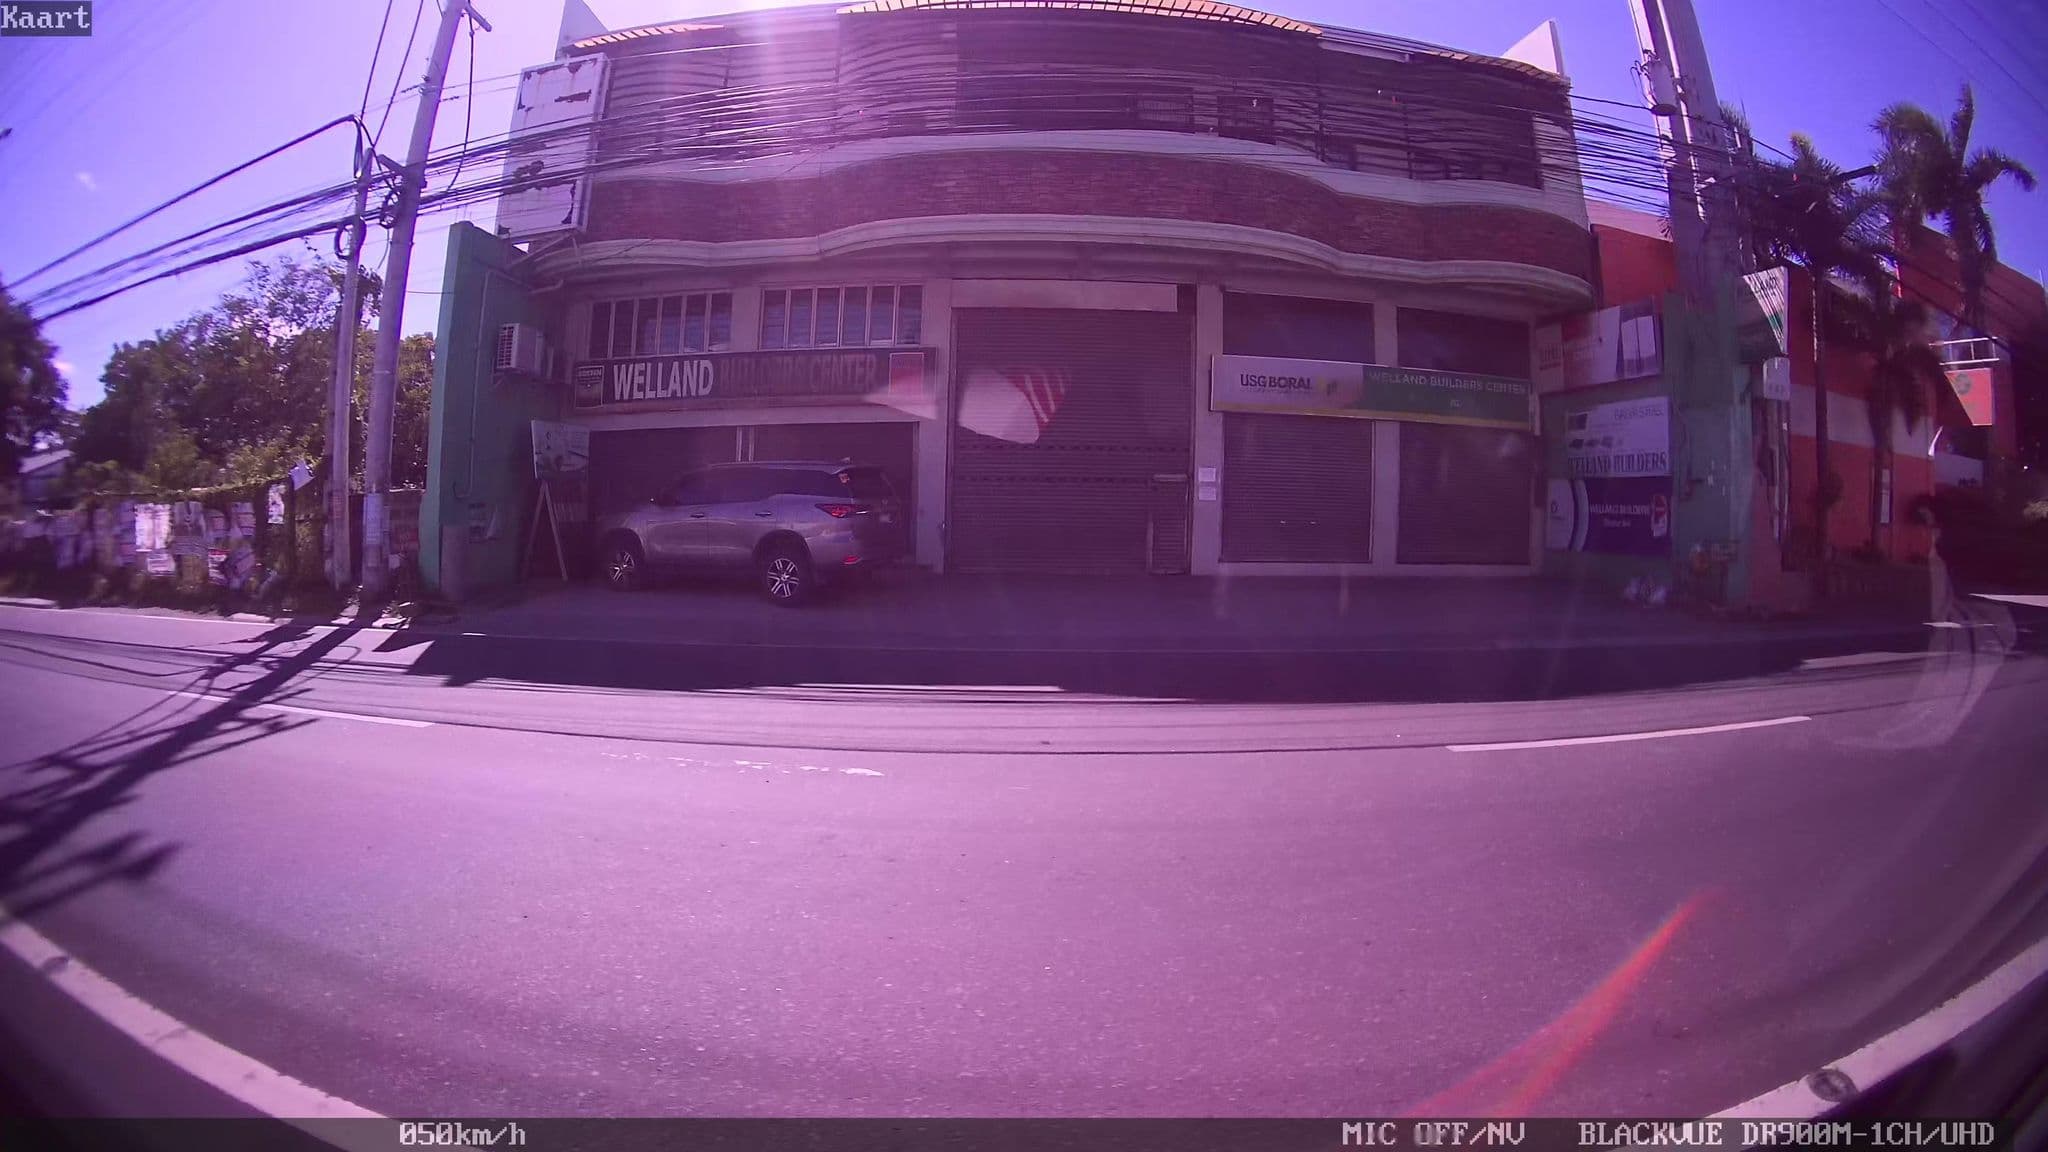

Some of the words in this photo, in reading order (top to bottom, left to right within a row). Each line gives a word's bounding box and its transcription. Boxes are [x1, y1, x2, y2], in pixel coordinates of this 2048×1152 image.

[613, 359, 714, 401] WELLAND
[1240, 373, 1267, 388] USG
[1366, 370, 1426, 386] WELLAND
[1429, 375, 1482, 392] BUILDERS
